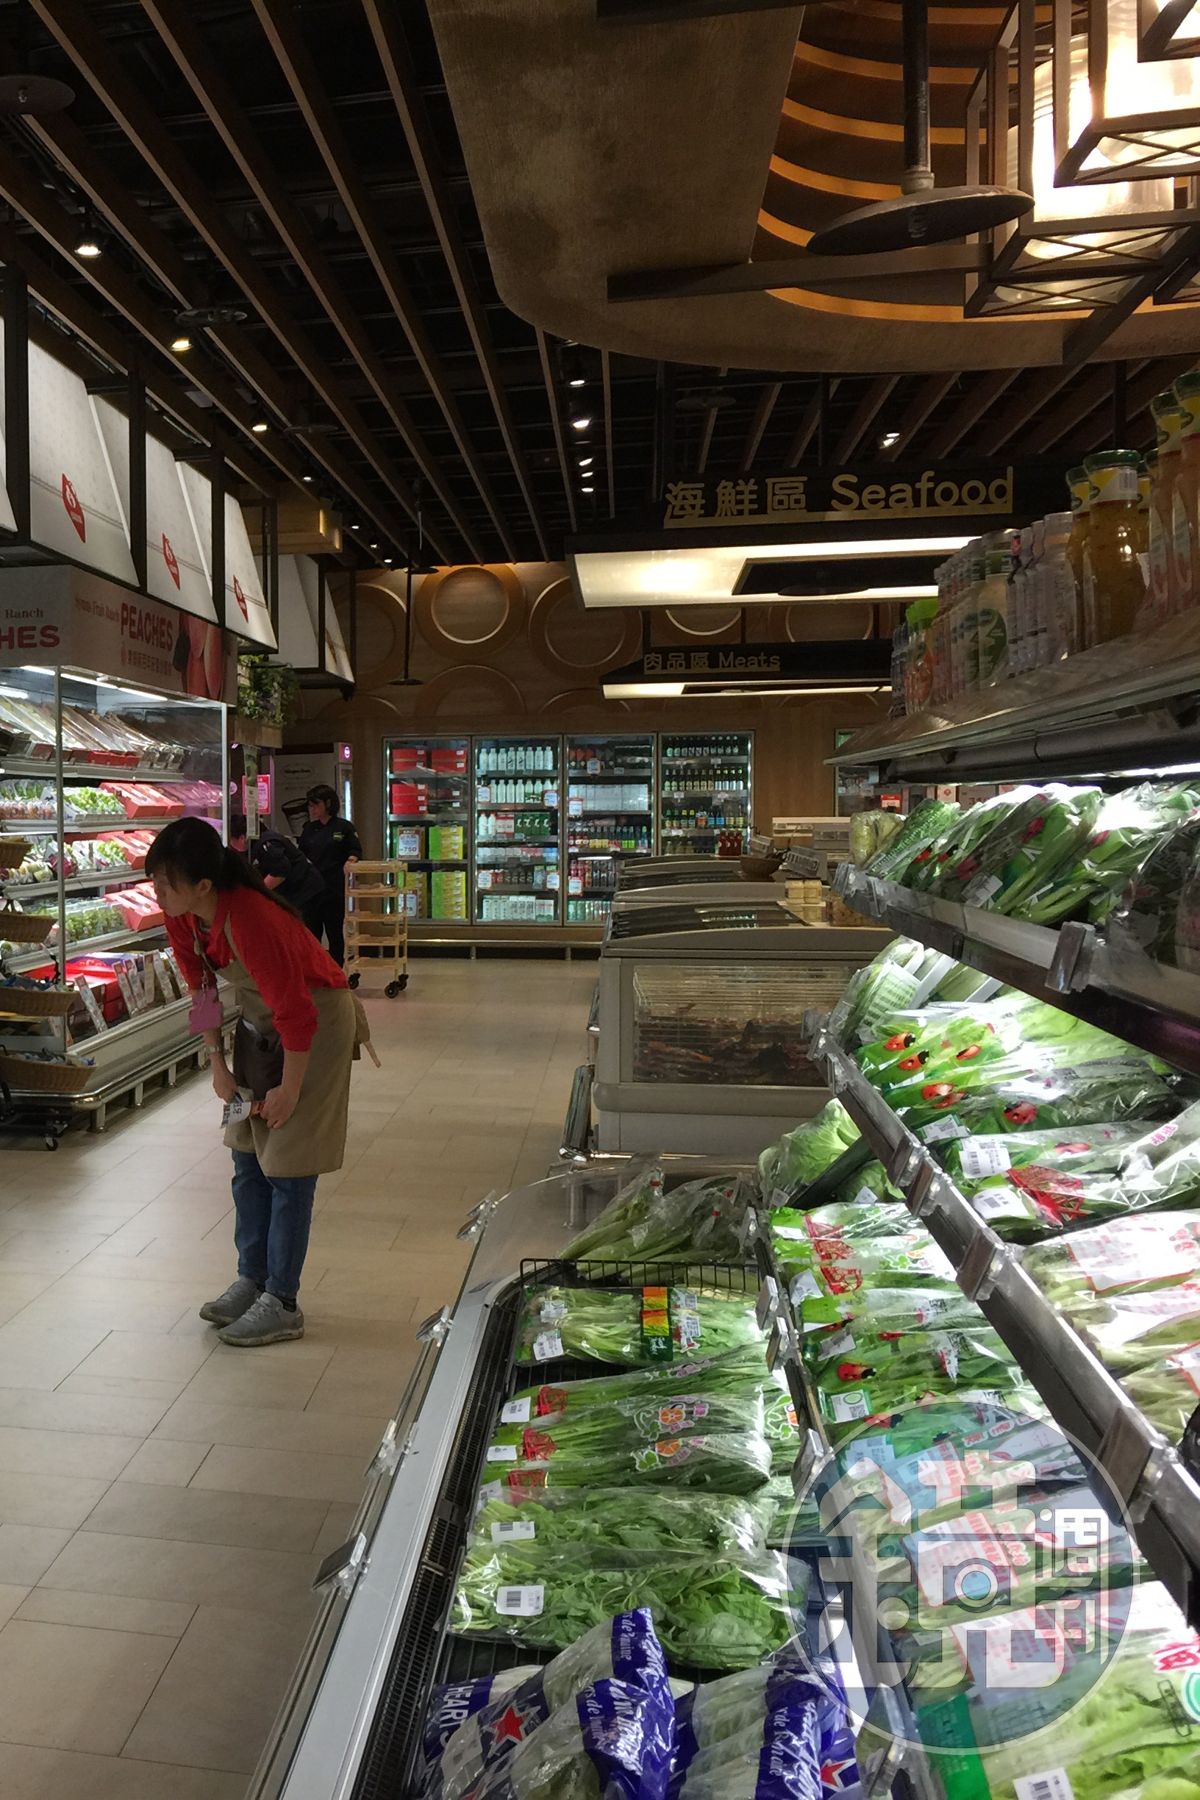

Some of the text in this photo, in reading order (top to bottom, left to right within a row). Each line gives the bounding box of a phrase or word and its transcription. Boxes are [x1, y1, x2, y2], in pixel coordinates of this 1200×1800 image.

[665, 465, 1013, 520] 海鮮區 Seafood
[5, 608, 44, 619] Ranch
[120, 602, 173, 652] PEACHES
[644, 651, 780, 671] 肉品區 Meats
